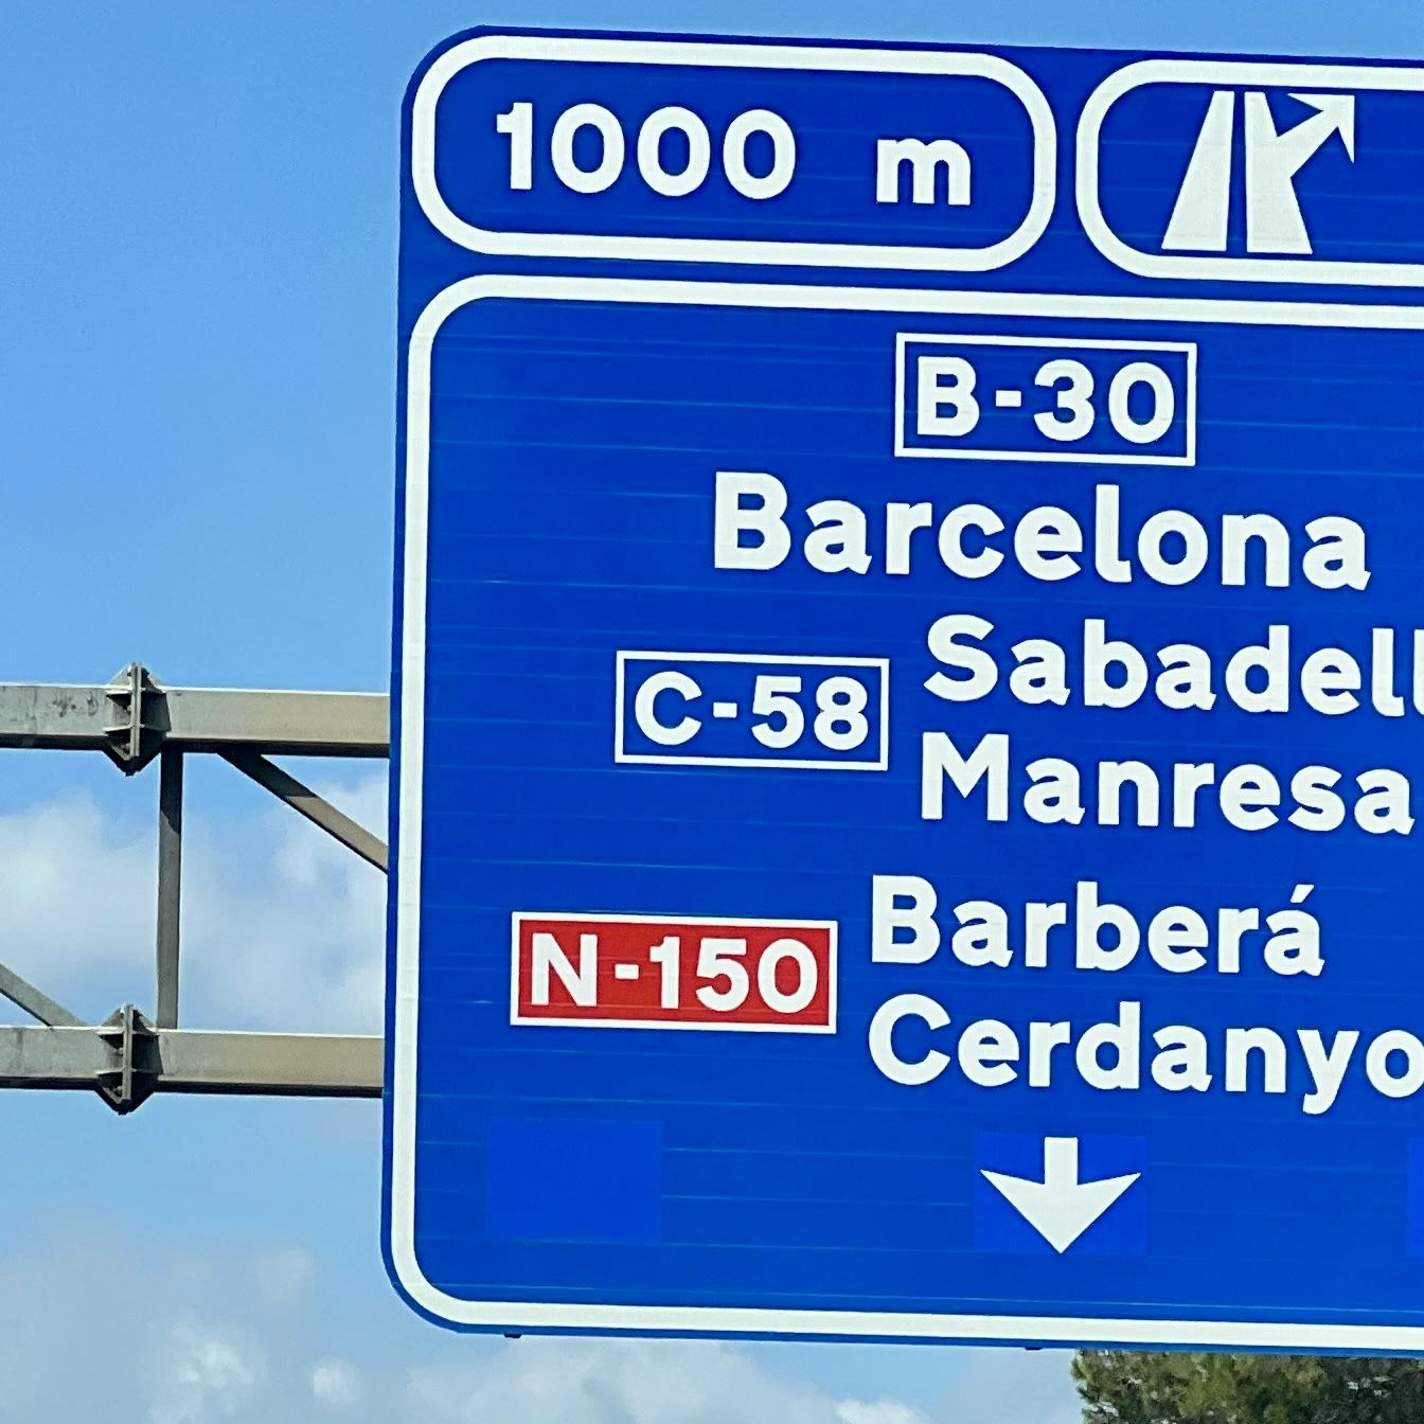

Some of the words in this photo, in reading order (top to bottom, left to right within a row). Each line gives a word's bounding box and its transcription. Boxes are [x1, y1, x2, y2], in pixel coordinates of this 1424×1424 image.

[495, 102, 796, 200] 1000
[876, 138, 972, 206] m
[916, 356, 1175, 444] B-30
[713, 472, 1372, 591] Barcelona
[635, 673, 869, 753] C-58
[920, 732, 1416, 835] Manresa
[530, 933, 819, 1015] N-150
[871, 875, 1326, 976] Barberá
